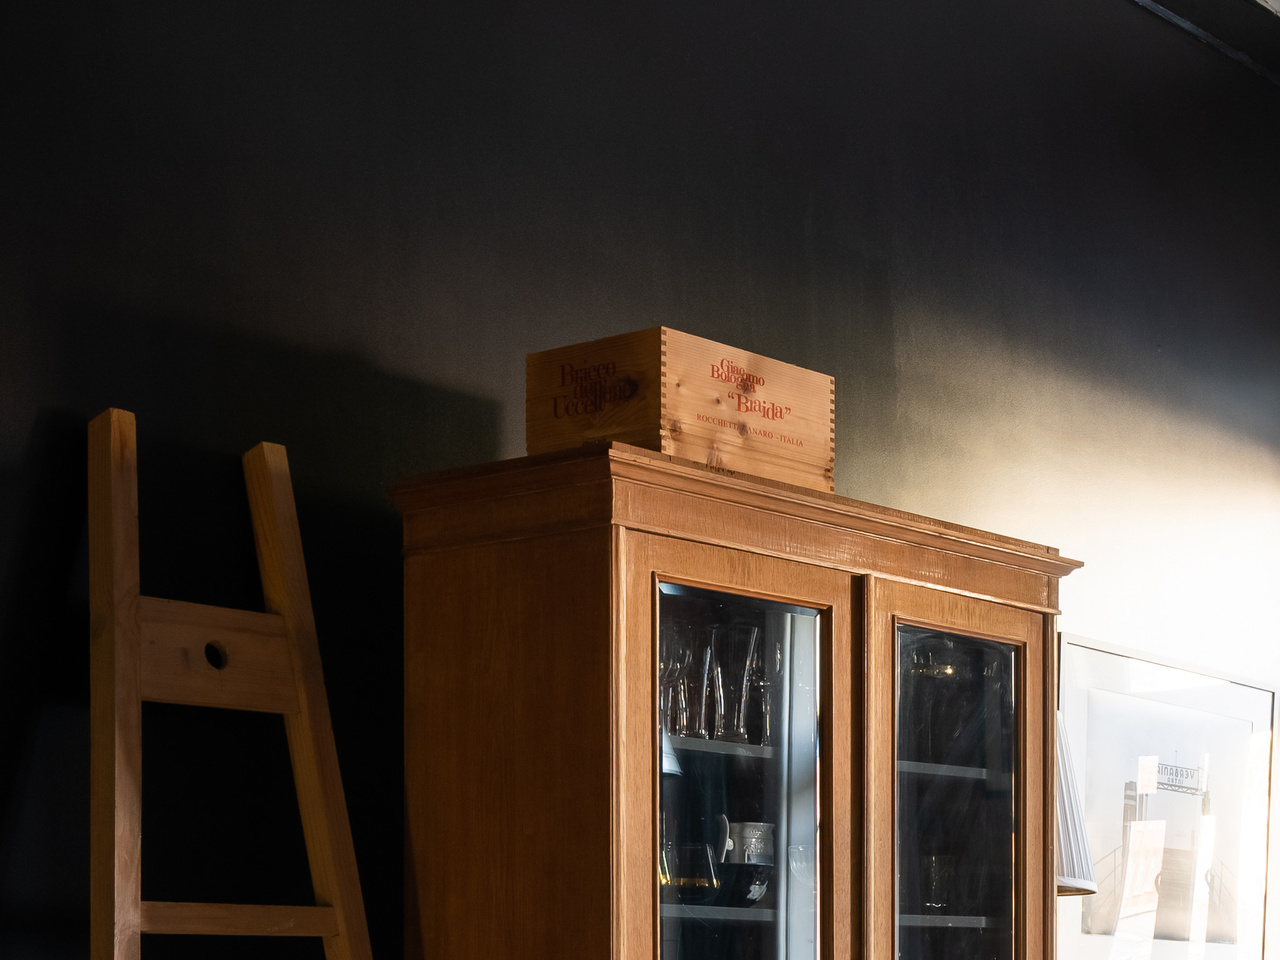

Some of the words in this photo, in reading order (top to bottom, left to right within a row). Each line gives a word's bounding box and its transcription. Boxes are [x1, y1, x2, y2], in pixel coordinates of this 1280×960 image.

[560, 360, 616, 388] Bricco
[720, 358, 765, 387] Giacomo
[780, 434, 804, 447] ITALIA
